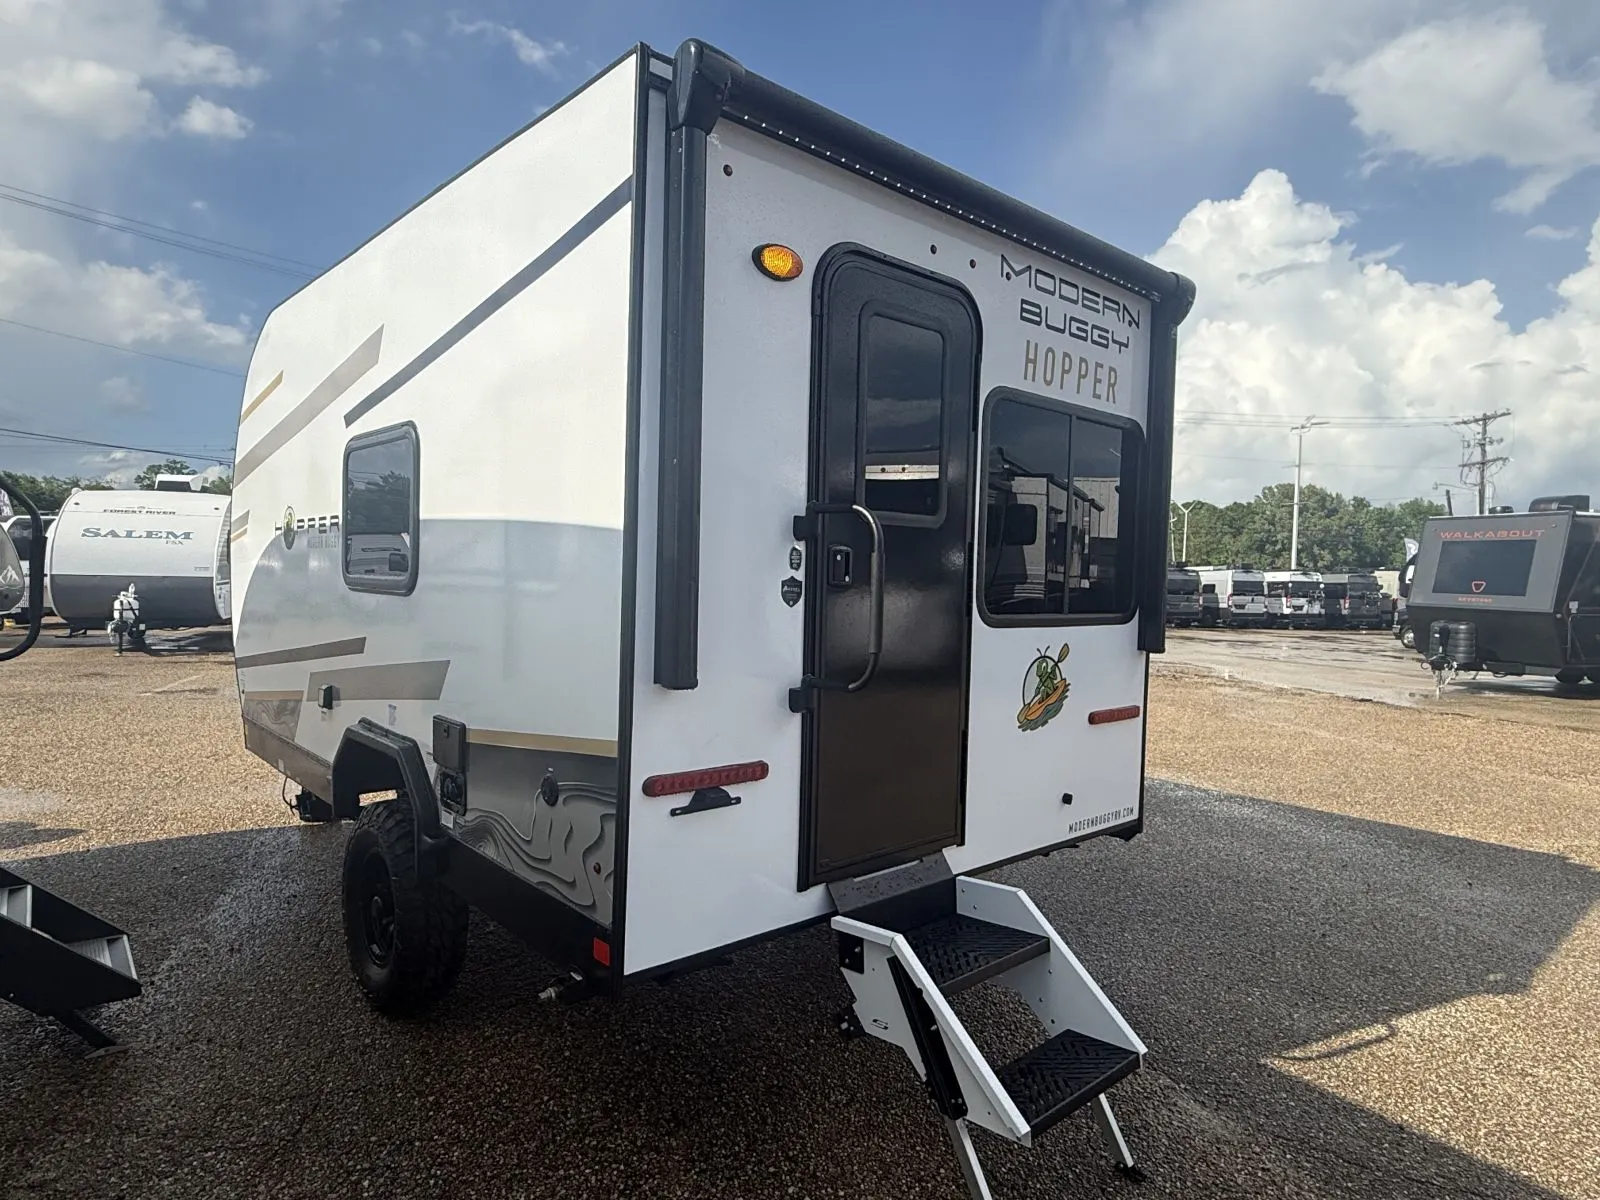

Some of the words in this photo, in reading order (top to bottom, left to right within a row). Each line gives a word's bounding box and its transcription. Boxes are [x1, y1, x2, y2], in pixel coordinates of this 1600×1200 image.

[1000, 253, 1140, 330] MODERN
[1019, 298, 1130, 354] BUGGY
[1023, 339, 1118, 405] HOPPER
[81, 527, 194, 540] SALEM
[1440, 529, 1546, 539] WALKABOUT
